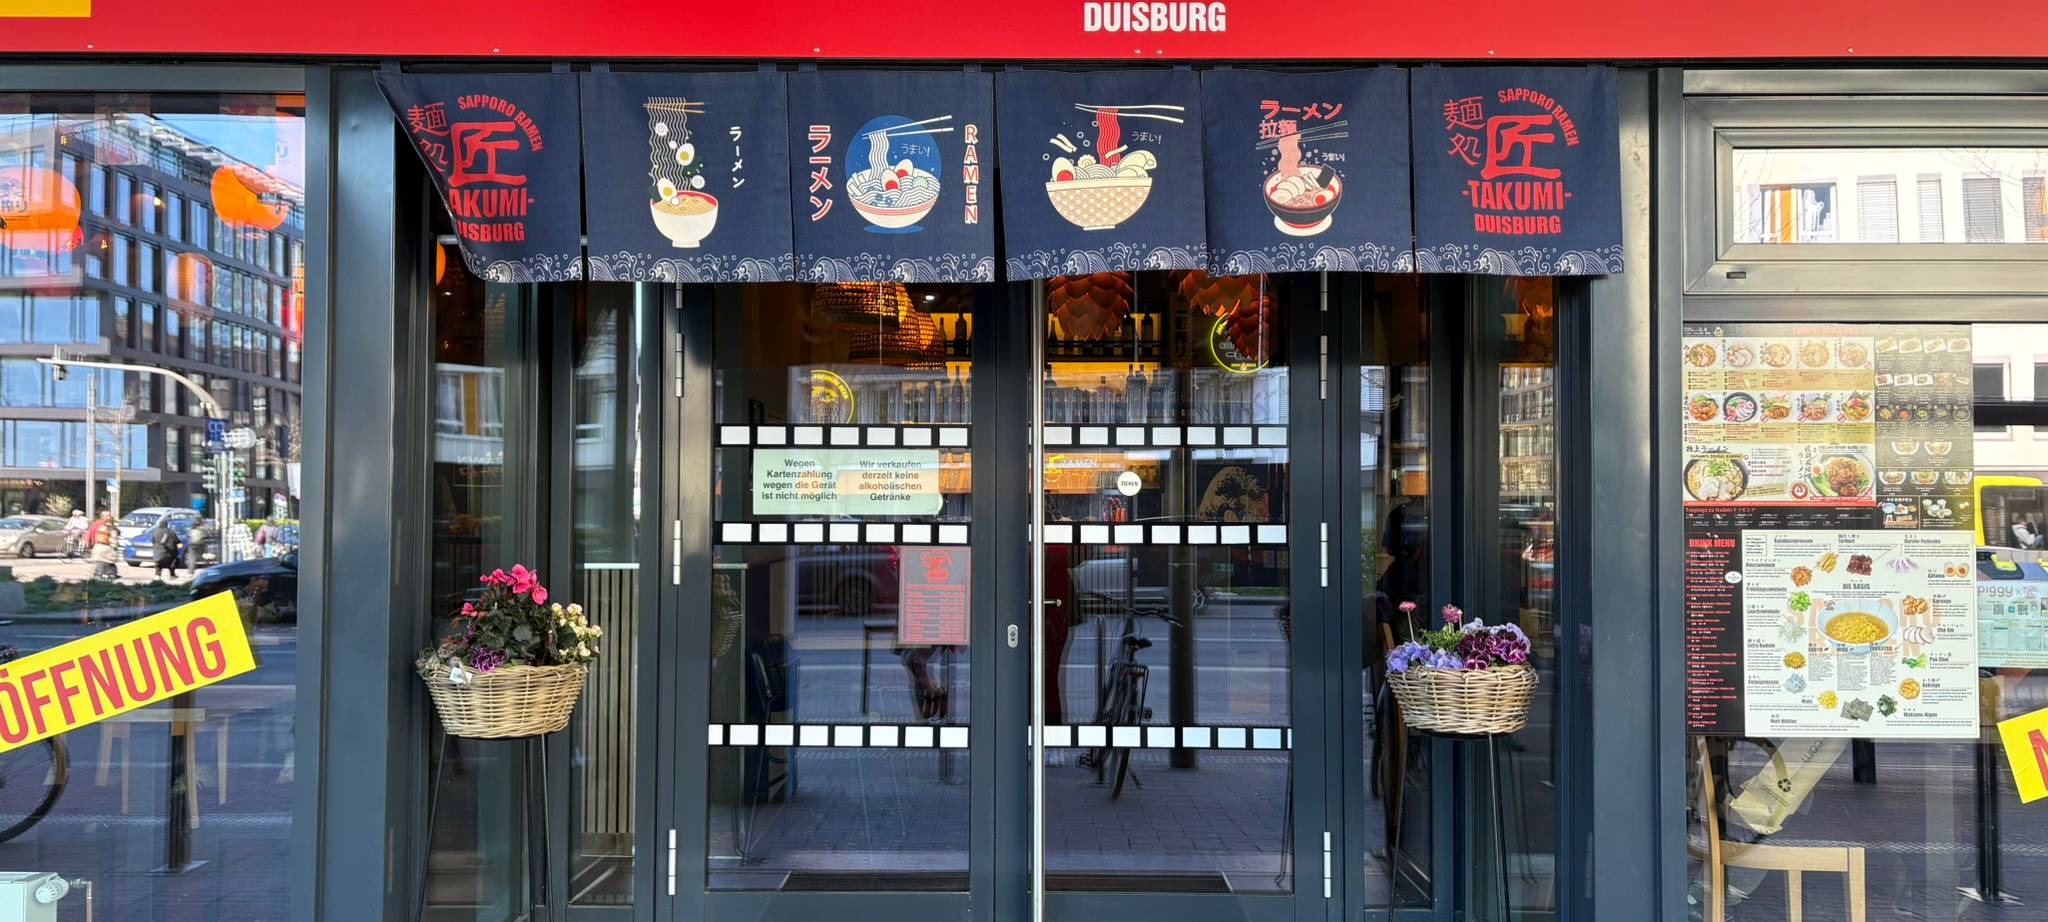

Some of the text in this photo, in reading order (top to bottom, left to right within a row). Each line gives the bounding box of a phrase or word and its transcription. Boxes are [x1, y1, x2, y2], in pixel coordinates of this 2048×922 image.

[1083, 2, 1226, 32] DUISBURG
[1260, 100, 1343, 121] ラーメン
[1497, 88, 1580, 147] SAPPORO RAMEN
[457, 94, 544, 153] SAPPORO RAMEN
[448, 121, 527, 188] 匠
[729, 126, 746, 189] ラーメン
[1480, 114, 1562, 180] 匠
[808, 124, 833, 222] ラーメン
[964, 124, 980, 225] RAMEN
[448, 187, 534, 218] AKUMI-
[1462, 180, 1572, 211] -TAKUMI-
[1474, 214, 1561, 235] DUISBURG
[784, 459, 815, 468] Wegen
[860, 460, 922, 468] Wir verkaufen
[766, 470, 833, 479] Kartenzahlung
[862, 471, 919, 479] derzeit keine
[763, 481, 836, 490] wegen die Gerät
[859, 482, 922, 490] alkoholischen
[762, 492, 837, 501] ist nicht möglich
[870, 493, 911, 501] Getränke
[1689, 539, 1735, 548] DRINK MENU
[1977, 585, 2013, 597] piggy
